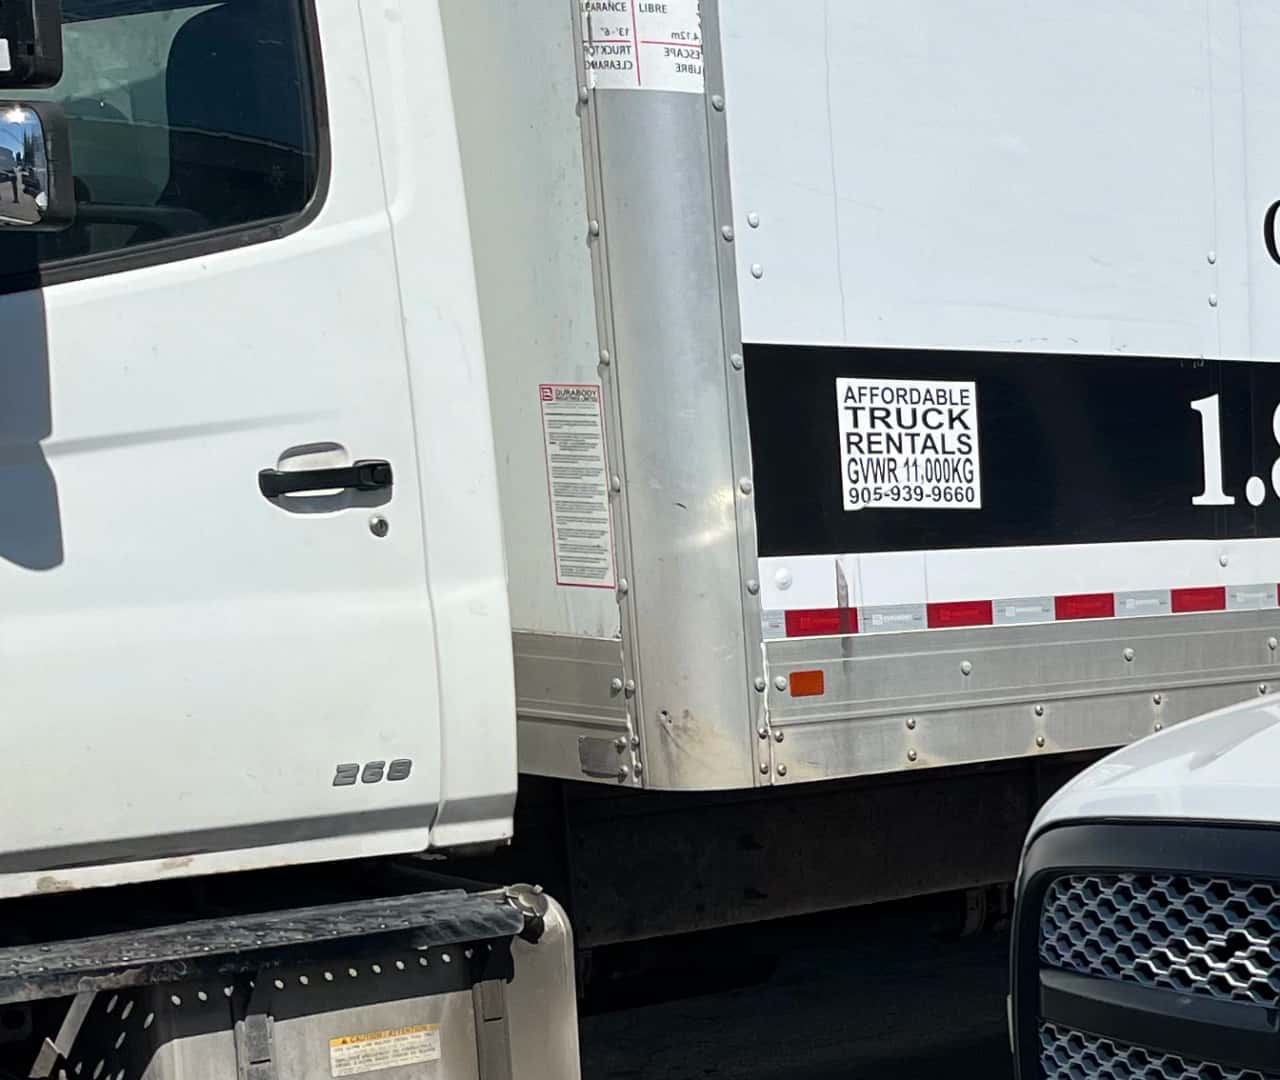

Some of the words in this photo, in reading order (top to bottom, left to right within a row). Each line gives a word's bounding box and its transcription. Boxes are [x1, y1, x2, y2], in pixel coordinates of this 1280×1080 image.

[639, 3, 668, 13] LIBRE
[844, 385, 971, 406] AFFORDABLE
[844, 406, 971, 430] TRUCK
[846, 432, 973, 455] RENTALS
[847, 457, 899, 484] GVWR
[849, 486, 975, 504] 905-939-9660
[332, 758, 412, 787] 268
